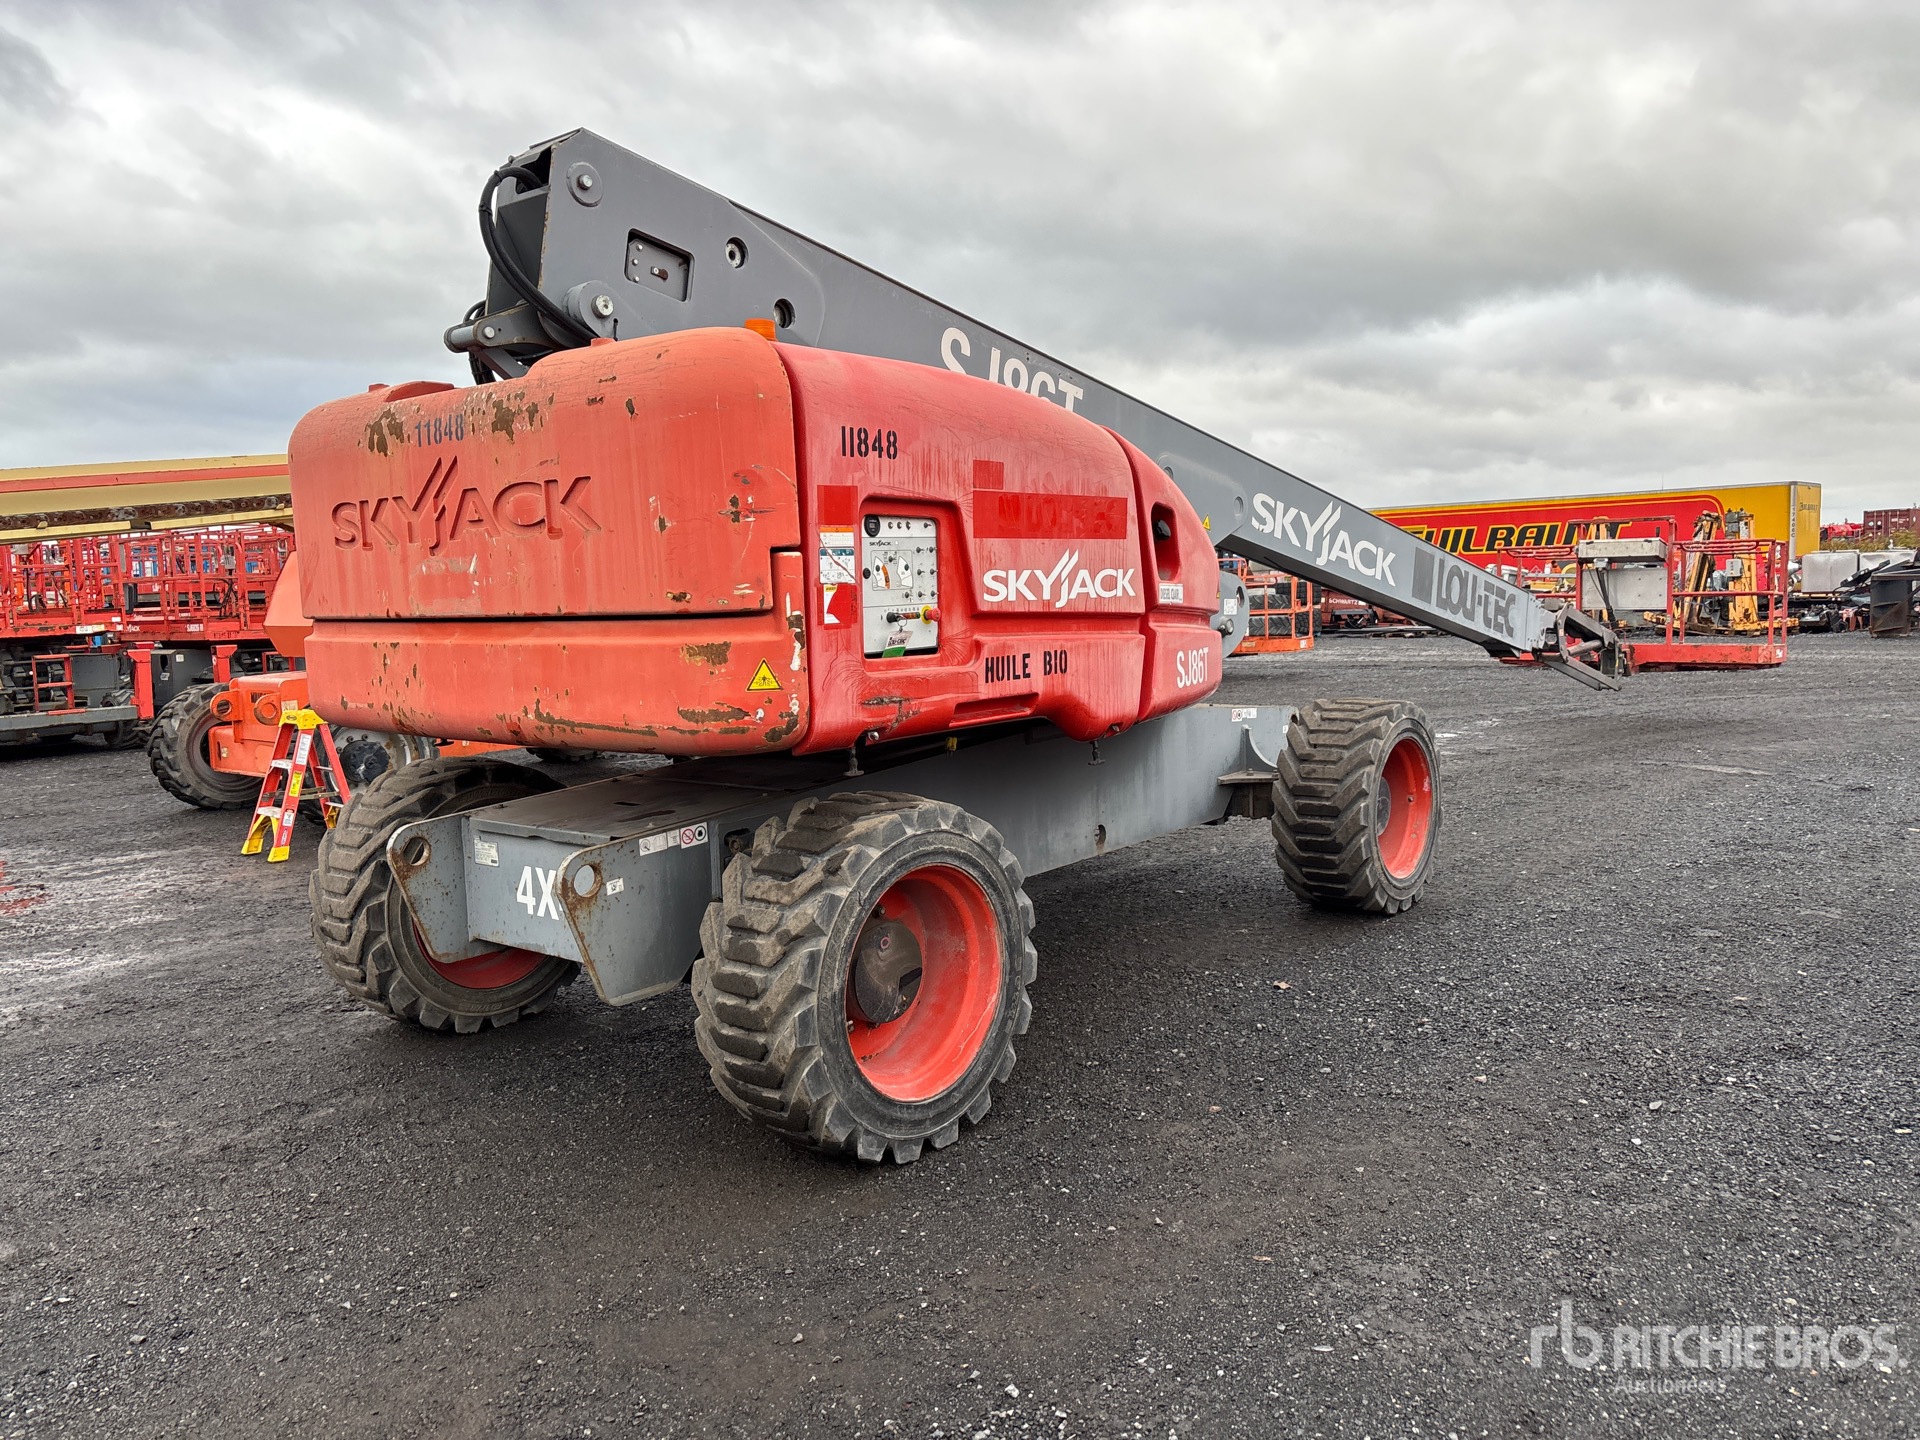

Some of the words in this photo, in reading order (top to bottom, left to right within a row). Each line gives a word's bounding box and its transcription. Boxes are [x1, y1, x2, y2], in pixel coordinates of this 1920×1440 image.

[415, 413, 465, 448] 11848
[841, 425, 898, 460] 11848
[331, 455, 601, 557] SKYJACK
[1251, 492, 1396, 587] SKYJACK
[1400, 523, 1631, 553] UILBAUT
[983, 548, 1136, 608] SKYJACK
[985, 653, 1031, 684] HUILE
[1043, 649, 1068, 676] BIO
[1176, 646, 1209, 688] SJ86T
[516, 864, 564, 921] 4X
